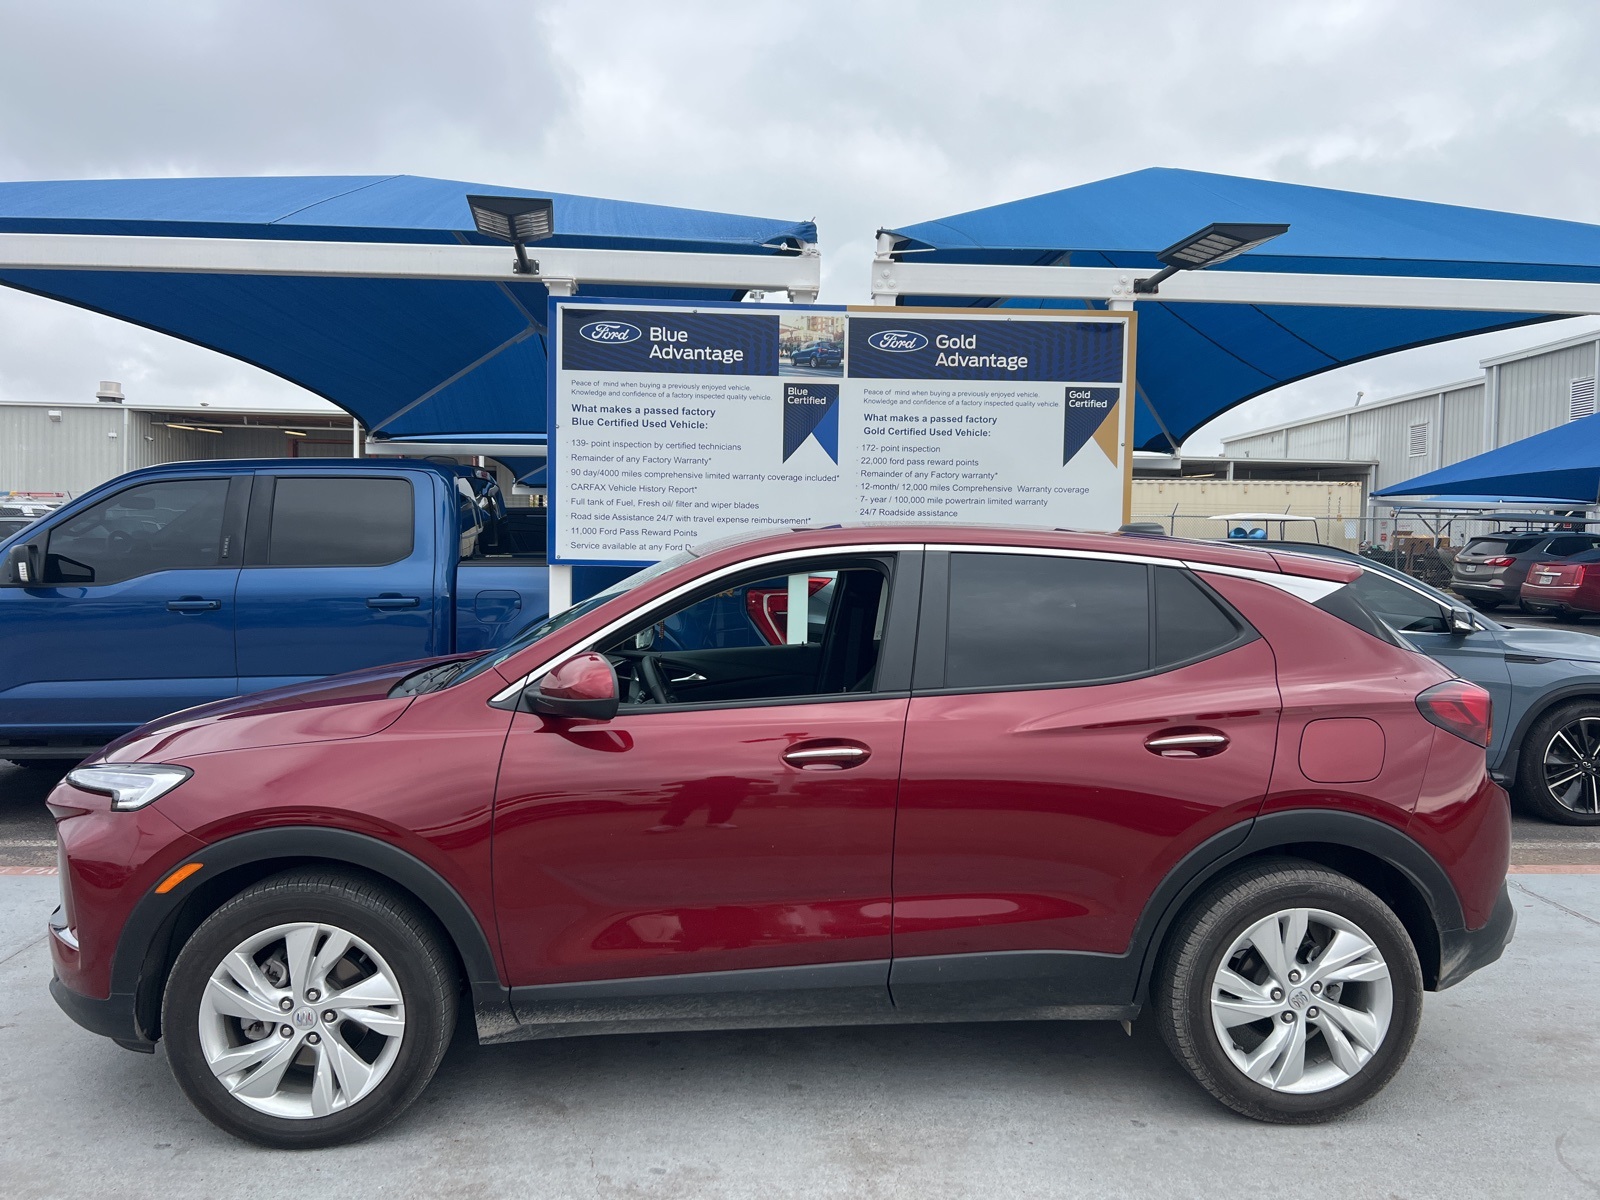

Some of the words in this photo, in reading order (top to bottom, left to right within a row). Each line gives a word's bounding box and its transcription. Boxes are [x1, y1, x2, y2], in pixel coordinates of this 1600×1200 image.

[591, 323, 630, 341] Ford
[649, 326, 688, 342] Blue
[879, 332, 917, 349] Ford
[935, 334, 977, 349] Gold
[649, 344, 744, 364] Advantage
[935, 352, 1028, 371] Advantage
[603, 380, 619, 388] mind
[639, 381, 661, 390] buying
[667, 383, 700, 391] previously
[701, 384, 727, 392] enjoyed
[787, 387, 809, 396] Blue
[571, 389, 607, 397] Knowledge
[672, 391, 694, 400] factory
[694, 392, 726, 401] inspected
[929, 390, 951, 398] buying
[990, 391, 1016, 399] enjoyed
[1068, 390, 1091, 399] Gold
[787, 396, 827, 405] Certified
[863, 397, 898, 406] Knowledge
[912, 398, 947, 406] confidence
[961, 400, 982, 408] factory
[983, 400, 1014, 408] inspected
[1068, 399, 1108, 408] Certified
[571, 404, 597, 413] What
[600, 405, 632, 414] makes
[643, 407, 679, 416] passed
[681, 407, 716, 418] factory
[571, 417, 594, 426] Blue
[596, 418, 639, 428] Certified
[641, 419, 667, 428] Used
[669, 420, 708, 430] Vehicle:
[863, 413, 888, 422] What
[889, 414, 920, 423] makes
[930, 415, 963, 424] passed
[965, 415, 998, 425] factory
[863, 427, 886, 436] Gold
[888, 427, 927, 436] Certified
[929, 428, 953, 436] Used
[955, 428, 991, 437] Vehicle:
[590, 440, 611, 448] point
[612, 440, 652, 449] inspection
[654, 441, 664, 451] by
[665, 441, 696, 450] certified
[698, 443, 742, 451] technicians
[880, 444, 900, 454] point
[901, 445, 941, 453] inspection
[570, 454, 614, 462] Remainder
[616, 454, 624, 463] of
[625, 456, 641, 464] any
[642, 455, 672, 465] Factory
[860, 457, 888, 465] 22,000
[889, 457, 905, 465] ford
[927, 458, 954, 466] reward
[955, 459, 979, 467] points
[570, 468, 581, 476] 90
[582, 469, 620, 478] day/4000
[621, 470, 642, 478] miles
[644, 470, 703, 479] comprehensive
[705, 472, 730, 480] limited
[732, 473, 766, 482] warranty
[767, 474, 803, 482] coverage
[860, 470, 903, 478] Remainder
[905, 470, 913, 478] of
[914, 472, 929, 480] any
[930, 471, 960, 481] Factory
[570, 483, 606, 491] CARFAX
[608, 484, 637, 492] Vehicle
[638, 484, 666, 495] History
[902, 483, 928, 492] 12,000
[929, 484, 950, 492] miles
[952, 484, 1013, 493] Comprehensive
[1017, 485, 1052, 495] Warranty
[1053, 486, 1090, 495] coverage
[570, 498, 586, 506] Full
[587, 498, 604, 506] tank
[606, 498, 615, 506] of
[616, 499, 636, 508] Fuel,
[637, 499, 660, 507] Fresh
[675, 500, 692, 508] filter
[711, 502, 733, 510] wiper
[733, 502, 759, 510] blades
[870, 496, 887, 505] year
[894, 496, 926, 504] 100,000
[927, 496, 943, 504] mile
[945, 497, 986, 506] powertrain
[987, 498, 1013, 506] limited
[1015, 499, 1048, 507] warranty
[570, 512, 592, 521] Road
[593, 513, 611, 521] side
[612, 513, 655, 522] Assistance
[656, 514, 673, 522] 24/7
[675, 514, 691, 522] with
[693, 515, 715, 523] travel
[859, 508, 877, 516] 24/7
[878, 509, 916, 517] Roadside
[916, 509, 958, 517] assistance
[571, 527, 597, 536] 11,000
[599, 528, 618, 536] Ford
[619, 528, 639, 536] Pass
[641, 528, 672, 537] Reward
[673, 529, 698, 537] Points
[570, 541, 600, 550] Service
[602, 542, 637, 550] available
[638, 542, 647, 551] at
[648, 544, 662, 552] any
[664, 543, 683, 551] Ford
